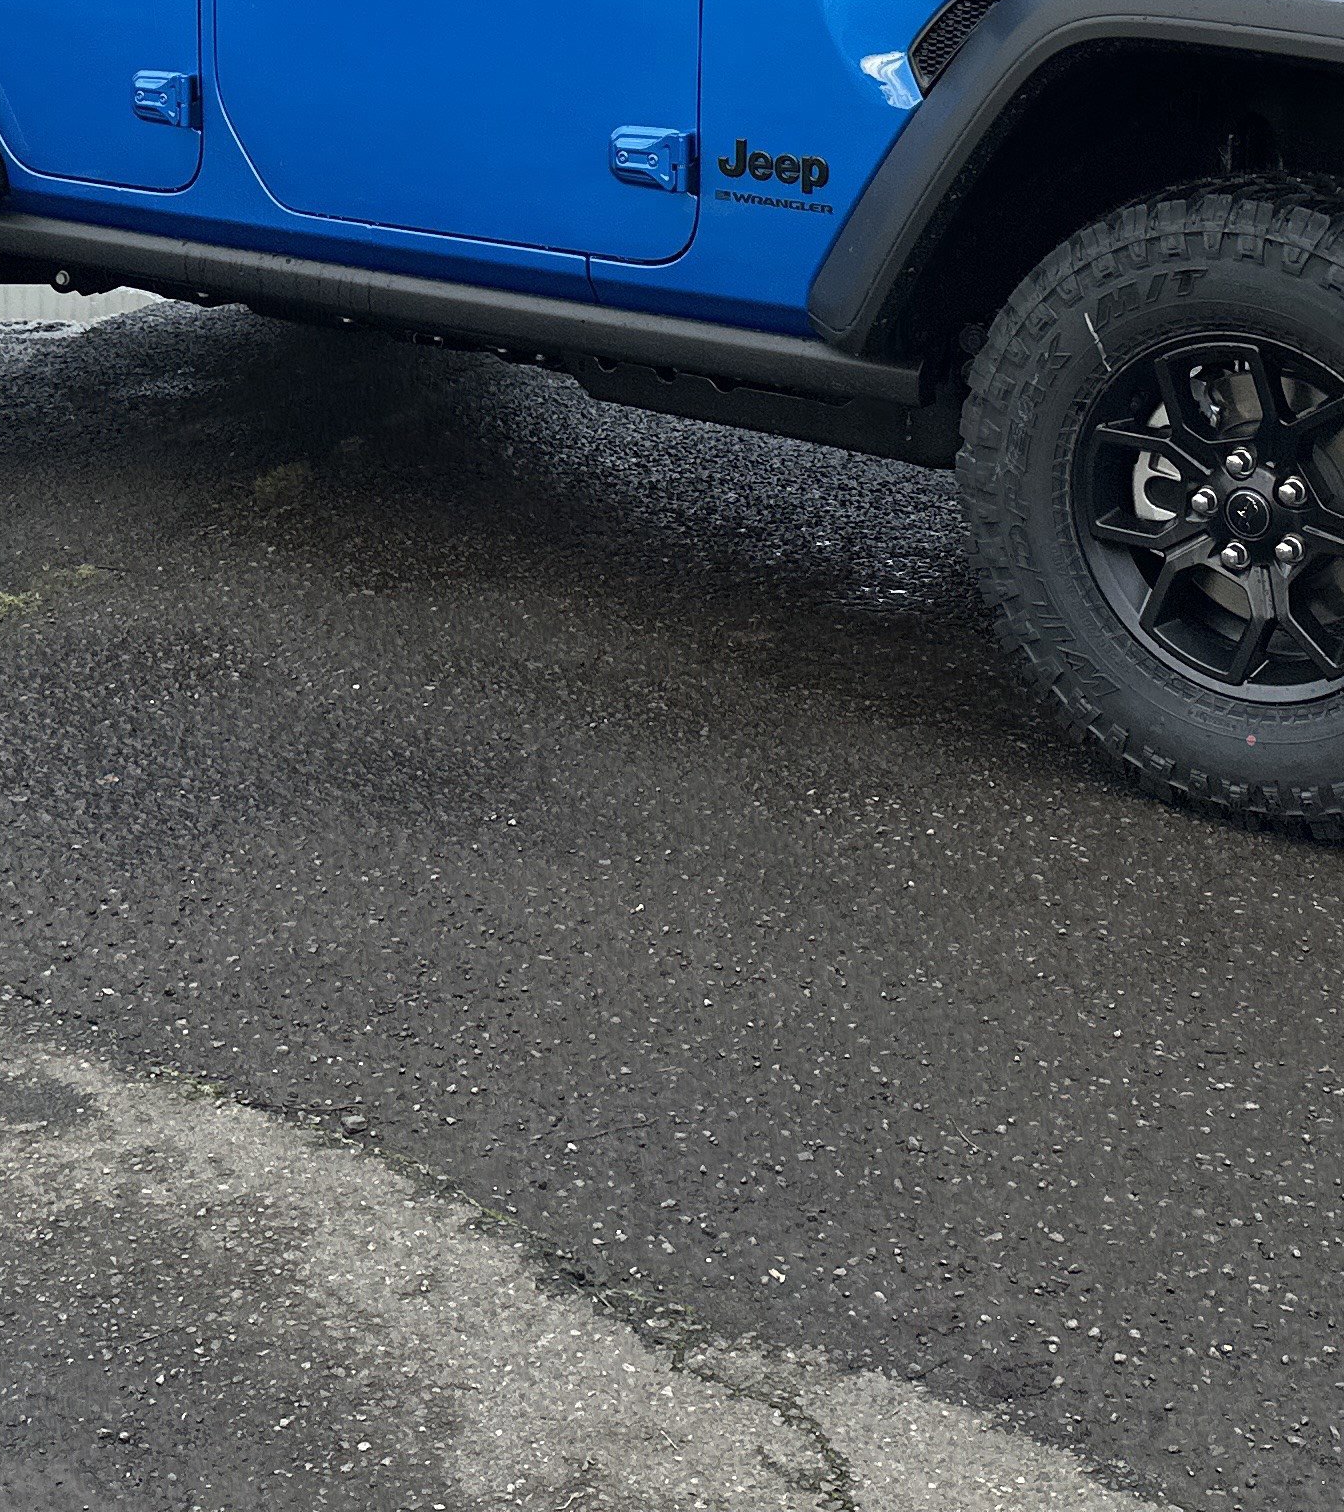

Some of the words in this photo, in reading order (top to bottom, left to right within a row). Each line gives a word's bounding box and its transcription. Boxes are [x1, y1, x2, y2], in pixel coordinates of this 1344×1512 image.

[717, 137, 830, 195] Jeep
[731, 191, 835, 216] WRANGLER
[1095, 267, 1209, 328] M/T
